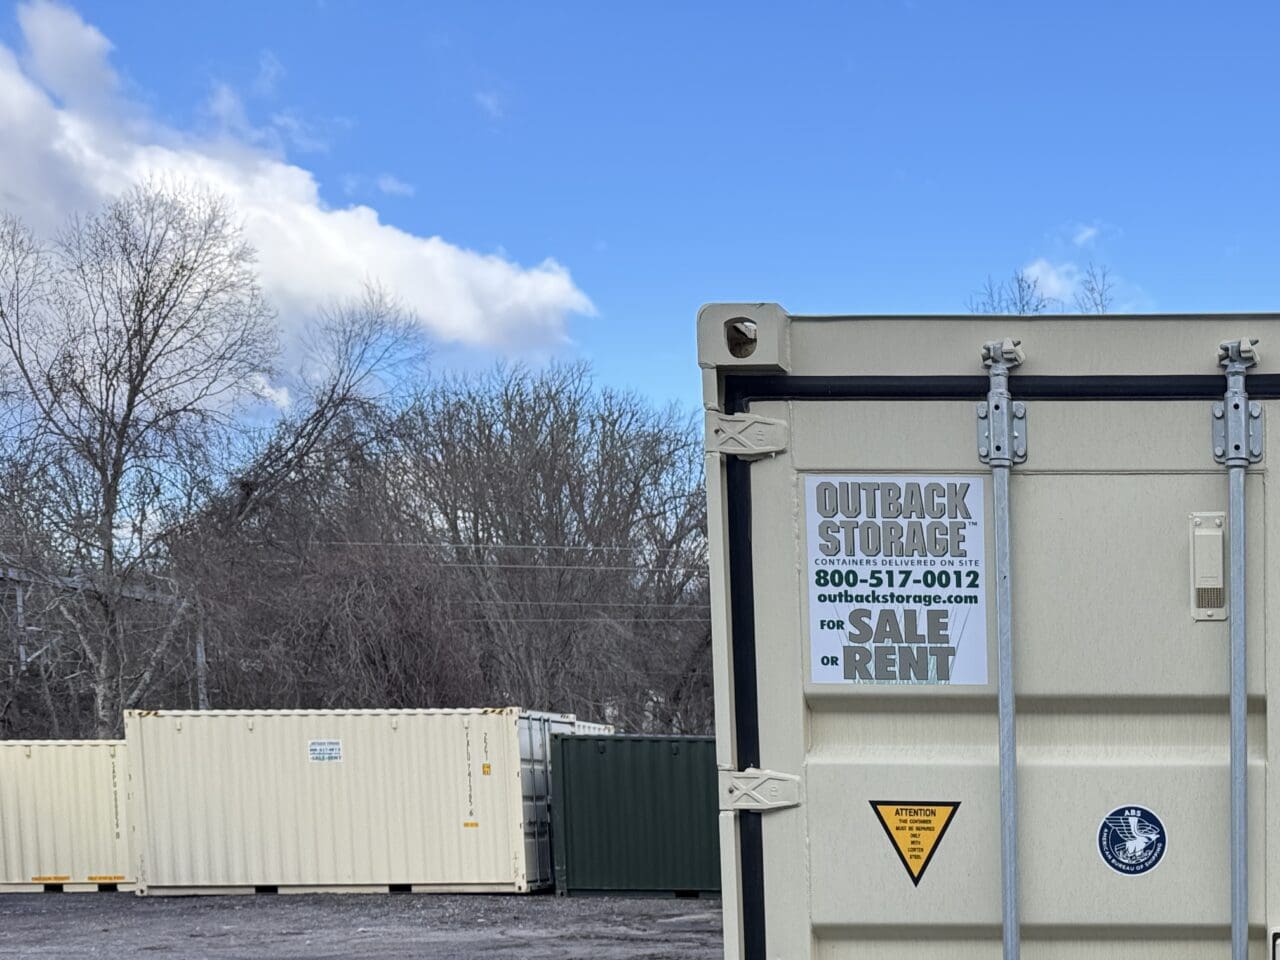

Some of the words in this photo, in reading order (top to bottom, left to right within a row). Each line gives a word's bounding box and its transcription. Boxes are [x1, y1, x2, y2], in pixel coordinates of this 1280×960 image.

[815, 481, 972, 519] OUTBACK
[818, 520, 967, 557] STORAGE
[814, 558, 878, 566] CONTAINERS
[881, 558, 936, 567] DELIVERED
[940, 559, 954, 567] ON
[958, 559, 980, 567] SITE
[815, 569, 979, 589] 800-517-0012
[817, 590, 978, 606] outbackstorage.com
[820, 620, 845, 630] FOR
[848, 608, 950, 644] SALE
[821, 656, 839, 666] OR
[842, 645, 956, 681] RENT
[895, 808, 936, 817] ATTENTION
[1124, 809, 1142, 817] ABS
